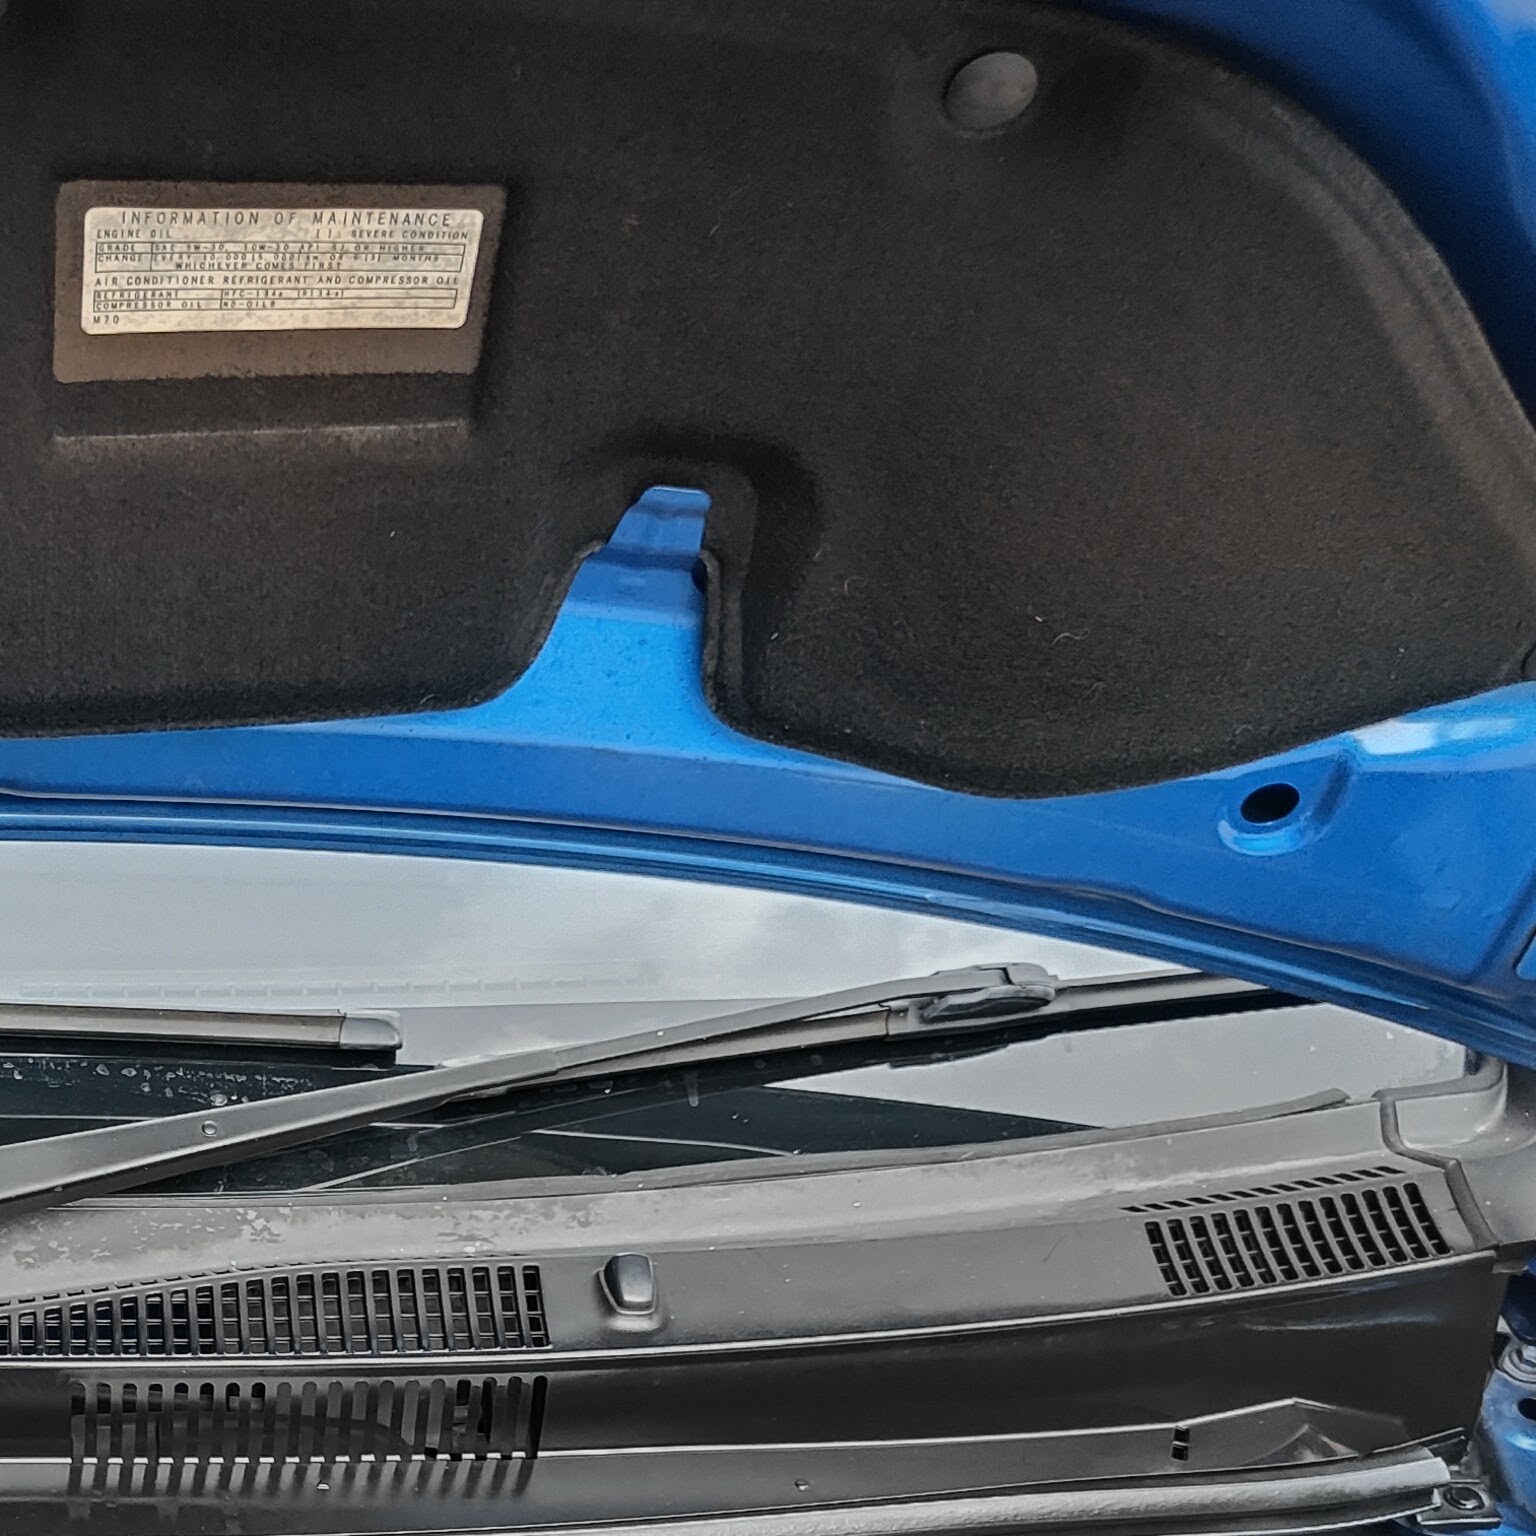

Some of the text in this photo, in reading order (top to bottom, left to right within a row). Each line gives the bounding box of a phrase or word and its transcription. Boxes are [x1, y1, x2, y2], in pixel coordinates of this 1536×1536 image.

[121, 210, 452, 226] INFORMATION OF MAINTENANCE
[96, 229, 173, 239] ENGINE OIL
[351, 229, 394, 239] SEVERE
[401, 230, 468, 240] CONDITION
[98, 243, 136, 252] GRADE
[175, 261, 341, 271] WHICHEVER COMES FIRST
[95, 274, 459, 287] AIR CONDITIONER REFRIGERANT AND COMPRESSOR OIL
[181, 300, 202, 310] OIL
